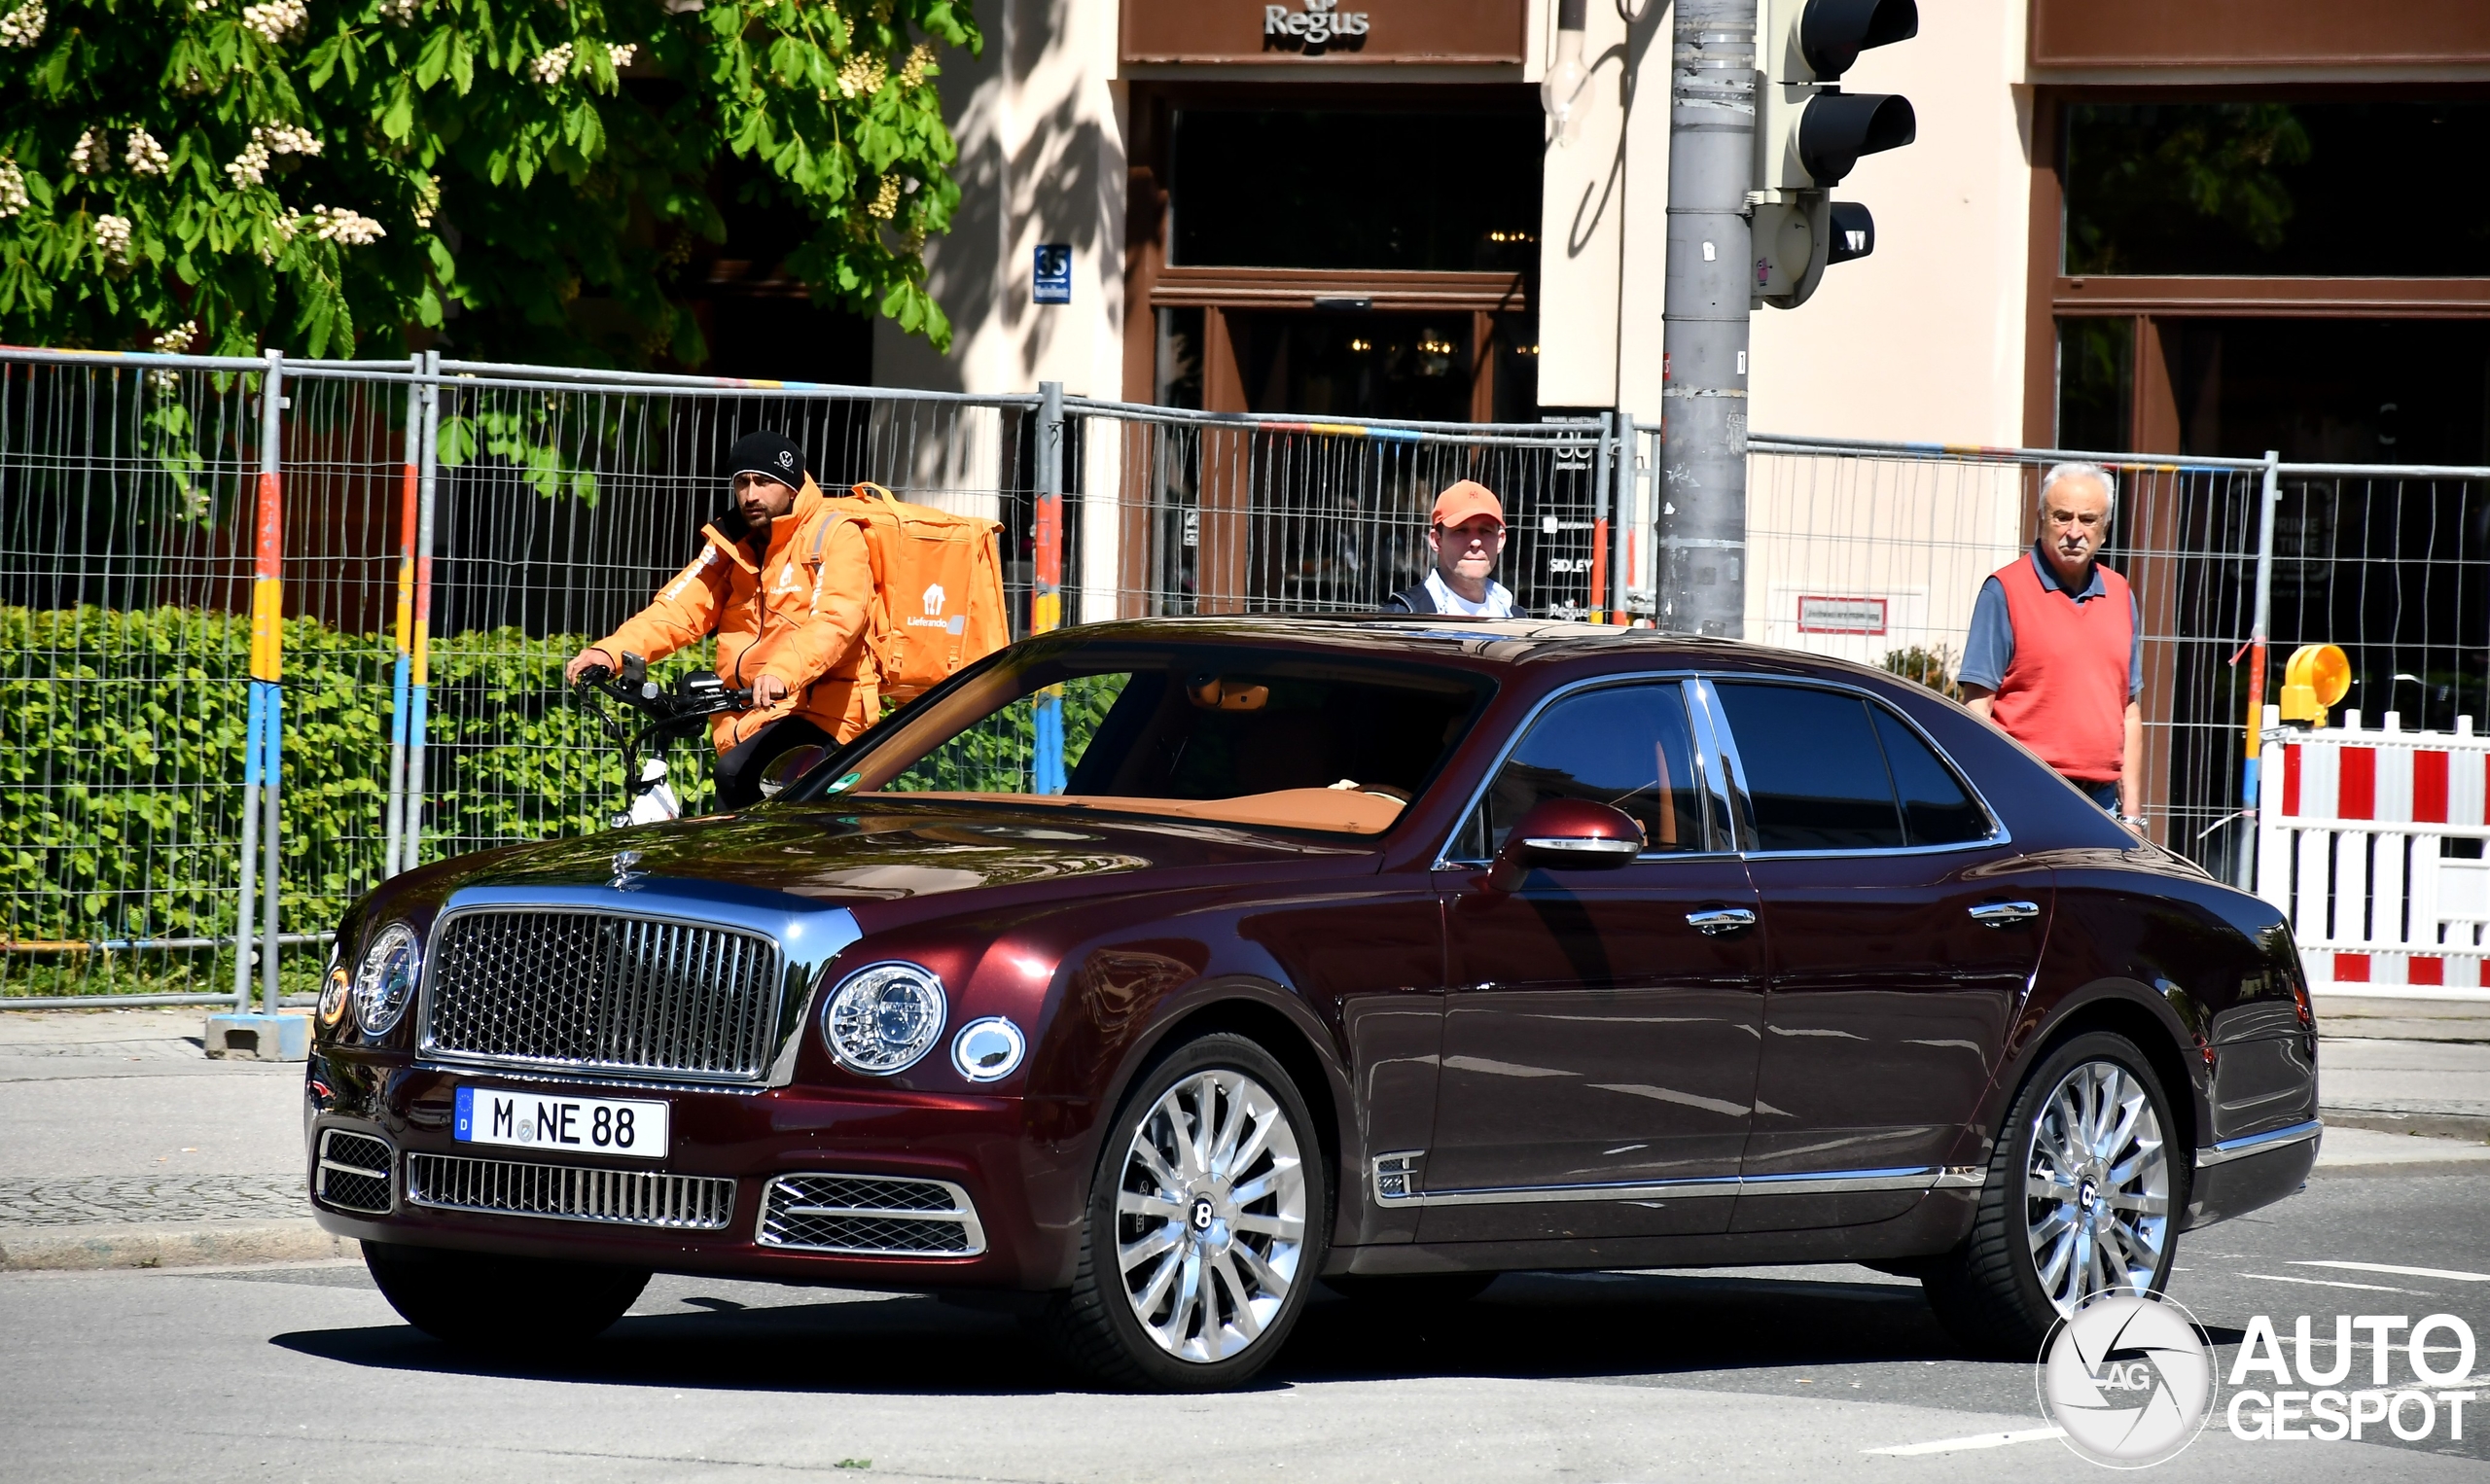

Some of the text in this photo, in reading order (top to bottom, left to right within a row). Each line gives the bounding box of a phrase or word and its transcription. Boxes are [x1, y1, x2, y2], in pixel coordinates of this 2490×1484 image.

[1264, 4, 1370, 44] Regus
[1037, 249, 1067, 276] 35
[1549, 558, 1594, 573] SIDLEY
[907, 616, 947, 628] Lieferando
[460, 1118, 468, 1131] D
[493, 1097, 635, 1148] M NE 88
[1194, 1203, 1212, 1228] B
